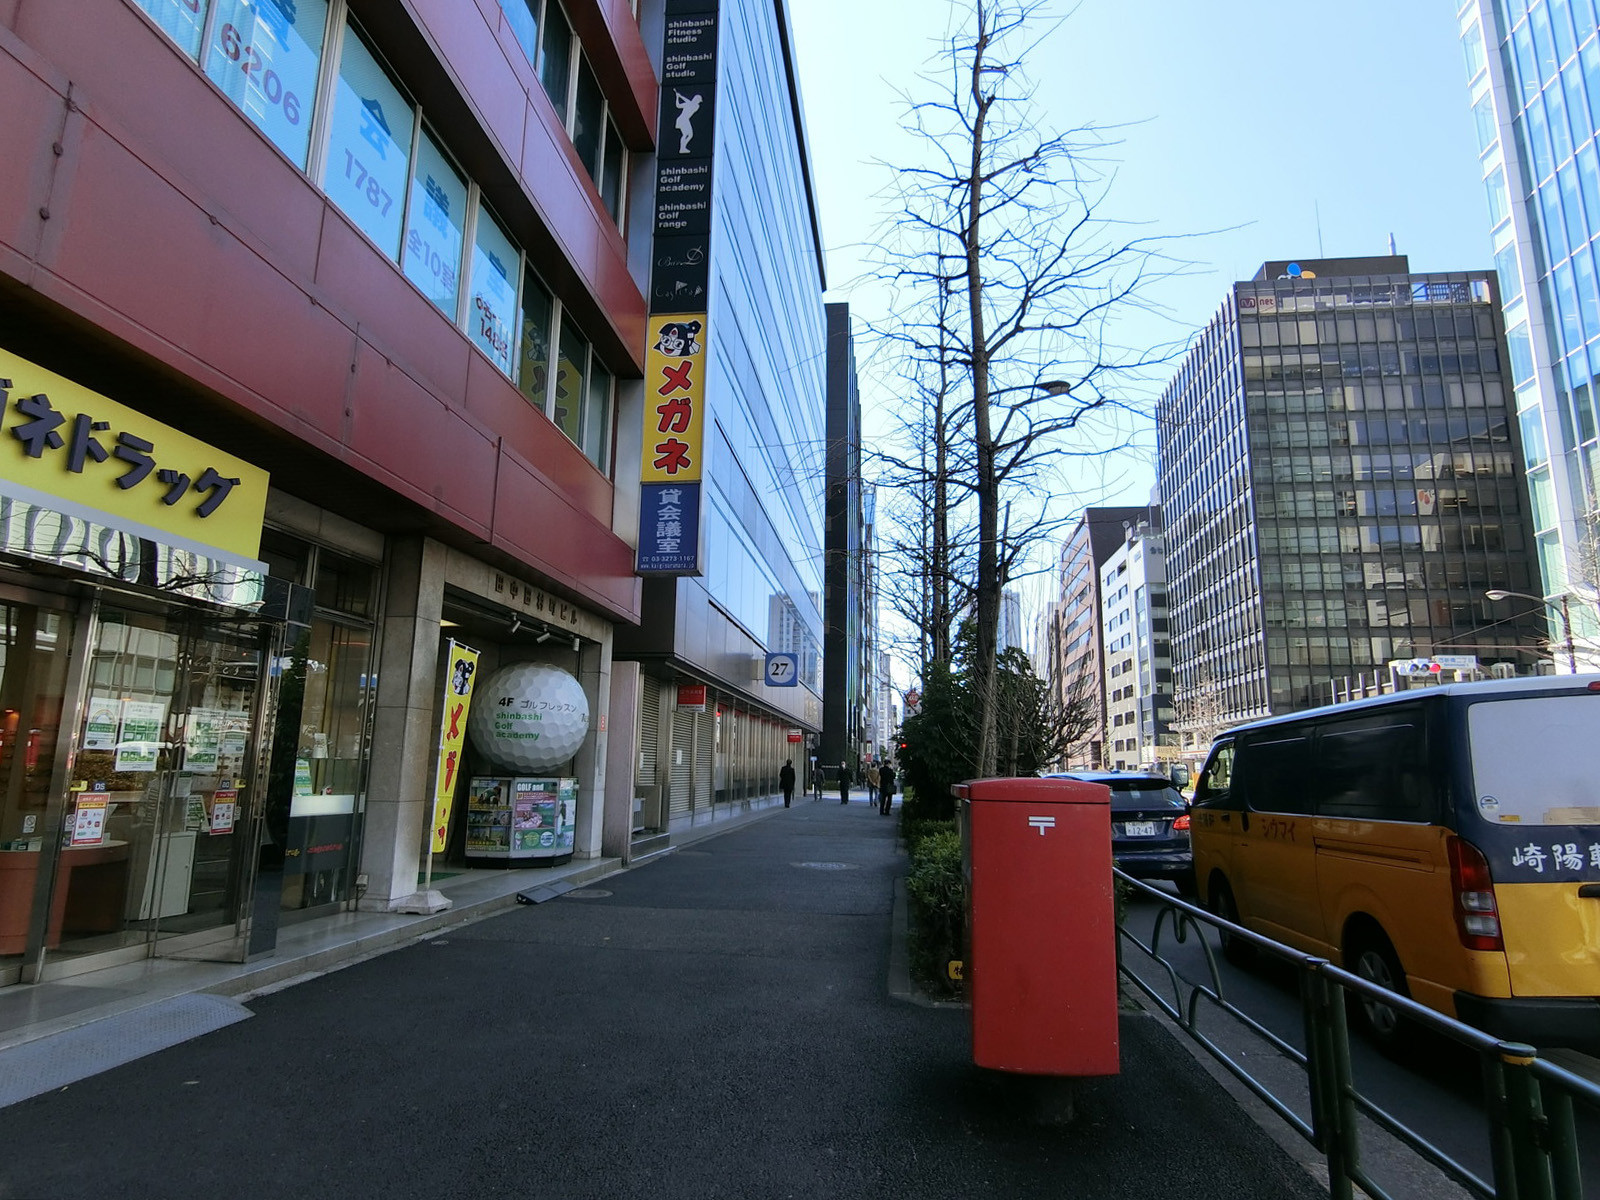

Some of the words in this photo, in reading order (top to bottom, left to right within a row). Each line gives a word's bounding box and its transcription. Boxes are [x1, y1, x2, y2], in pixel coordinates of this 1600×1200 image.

[668, 19, 714, 28] shinbashi
[668, 28, 702, 36] Fitness
[667, 35, 697, 43] studio
[666, 53, 712, 62] shinbashi
[666, 61, 686, 70] Golf
[665, 69, 696, 78] studio
[220, 23, 301, 126] 6206
[344, 147, 393, 218] 1787
[660, 166, 708, 175] shinbashi
[660, 174, 681, 184] Golf
[659, 183, 705, 193] academy
[658, 202, 706, 211] shinbashi
[658, 211, 679, 220] Golf
[658, 219, 688, 229] range
[653, 359, 694, 475] メガネ
[656, 488, 682, 553] 貸会議室
[771, 662, 789, 676] 27
[499, 697, 514, 707] 4F
[496, 712, 542, 721] shinbashi
[495, 722, 514, 730] Golf
[495, 731, 540, 741] academy
[517, 783, 532, 791] GOLF
